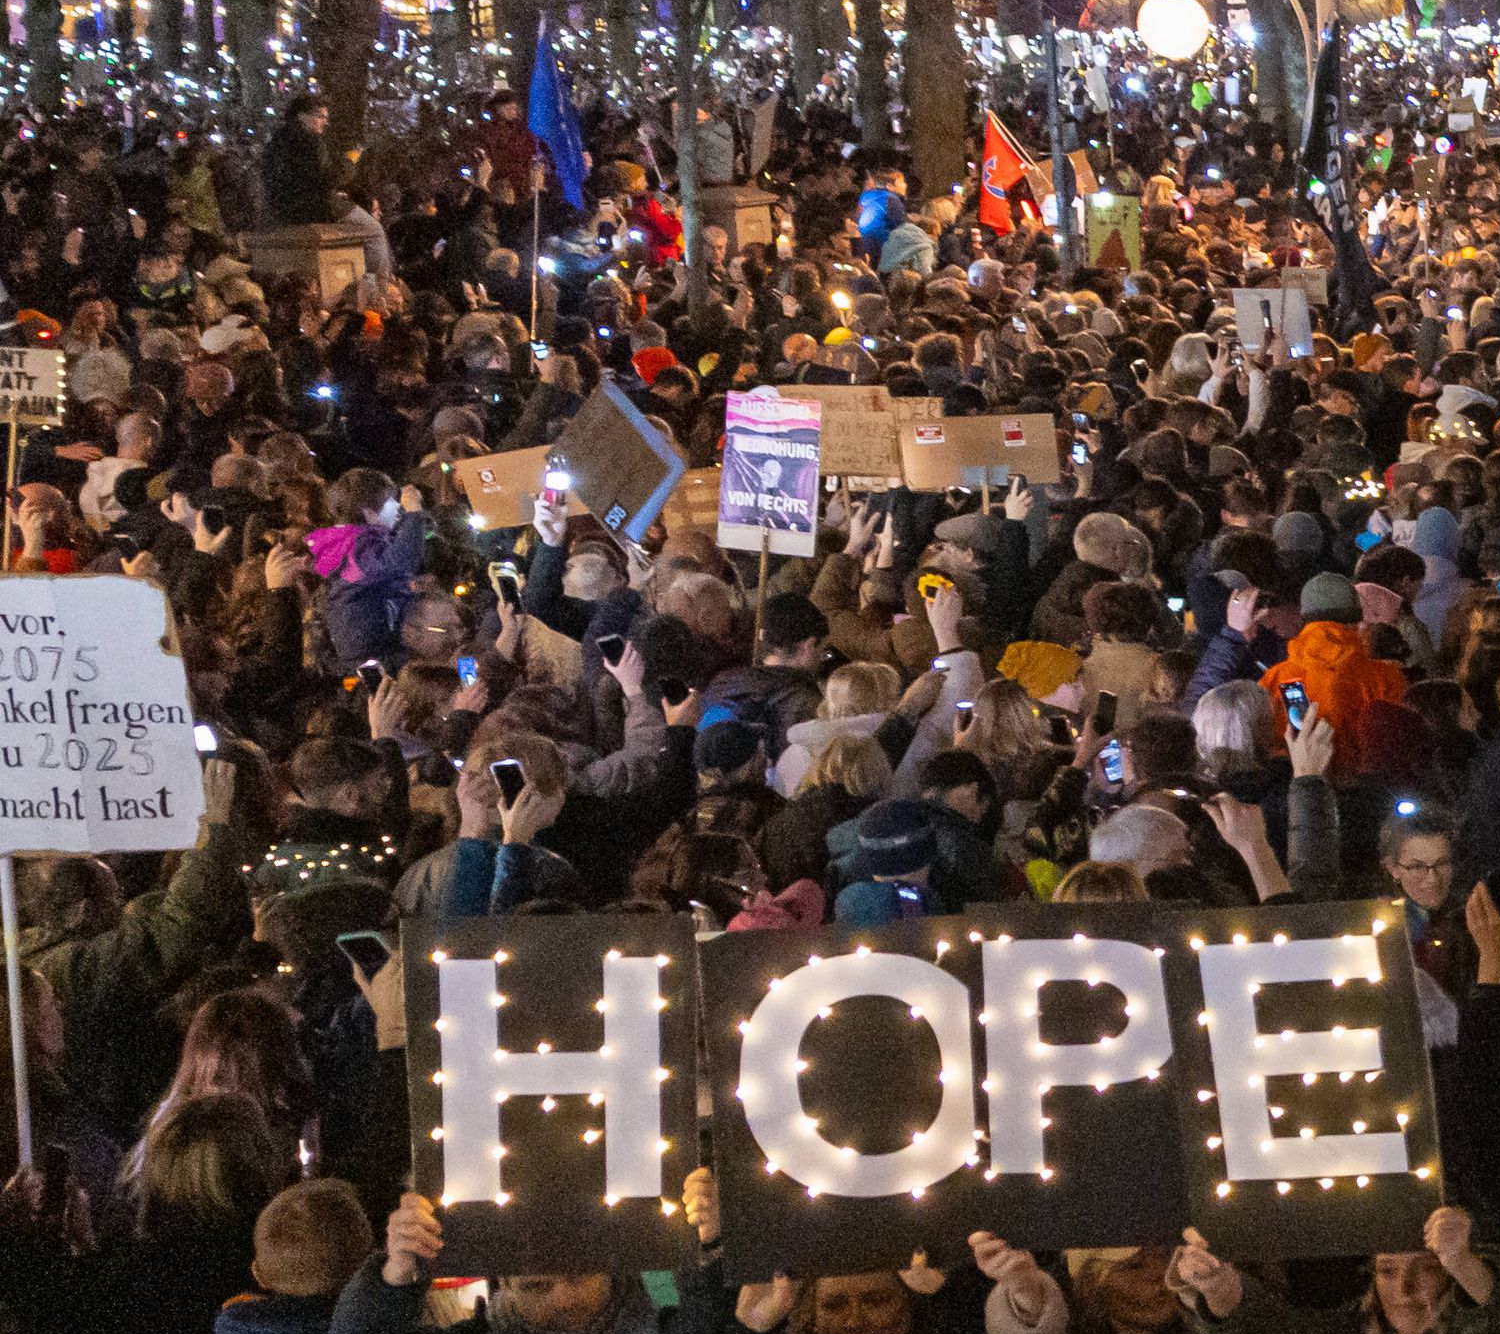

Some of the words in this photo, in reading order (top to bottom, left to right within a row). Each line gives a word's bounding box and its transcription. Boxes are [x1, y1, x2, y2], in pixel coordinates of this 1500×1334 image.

[728, 490, 756, 507] VON
[65, 688, 186, 740] fragen
[36, 732, 155, 776] 2025
[99, 785, 175, 821] hast
[438, 936, 1412, 1207] HOPE
